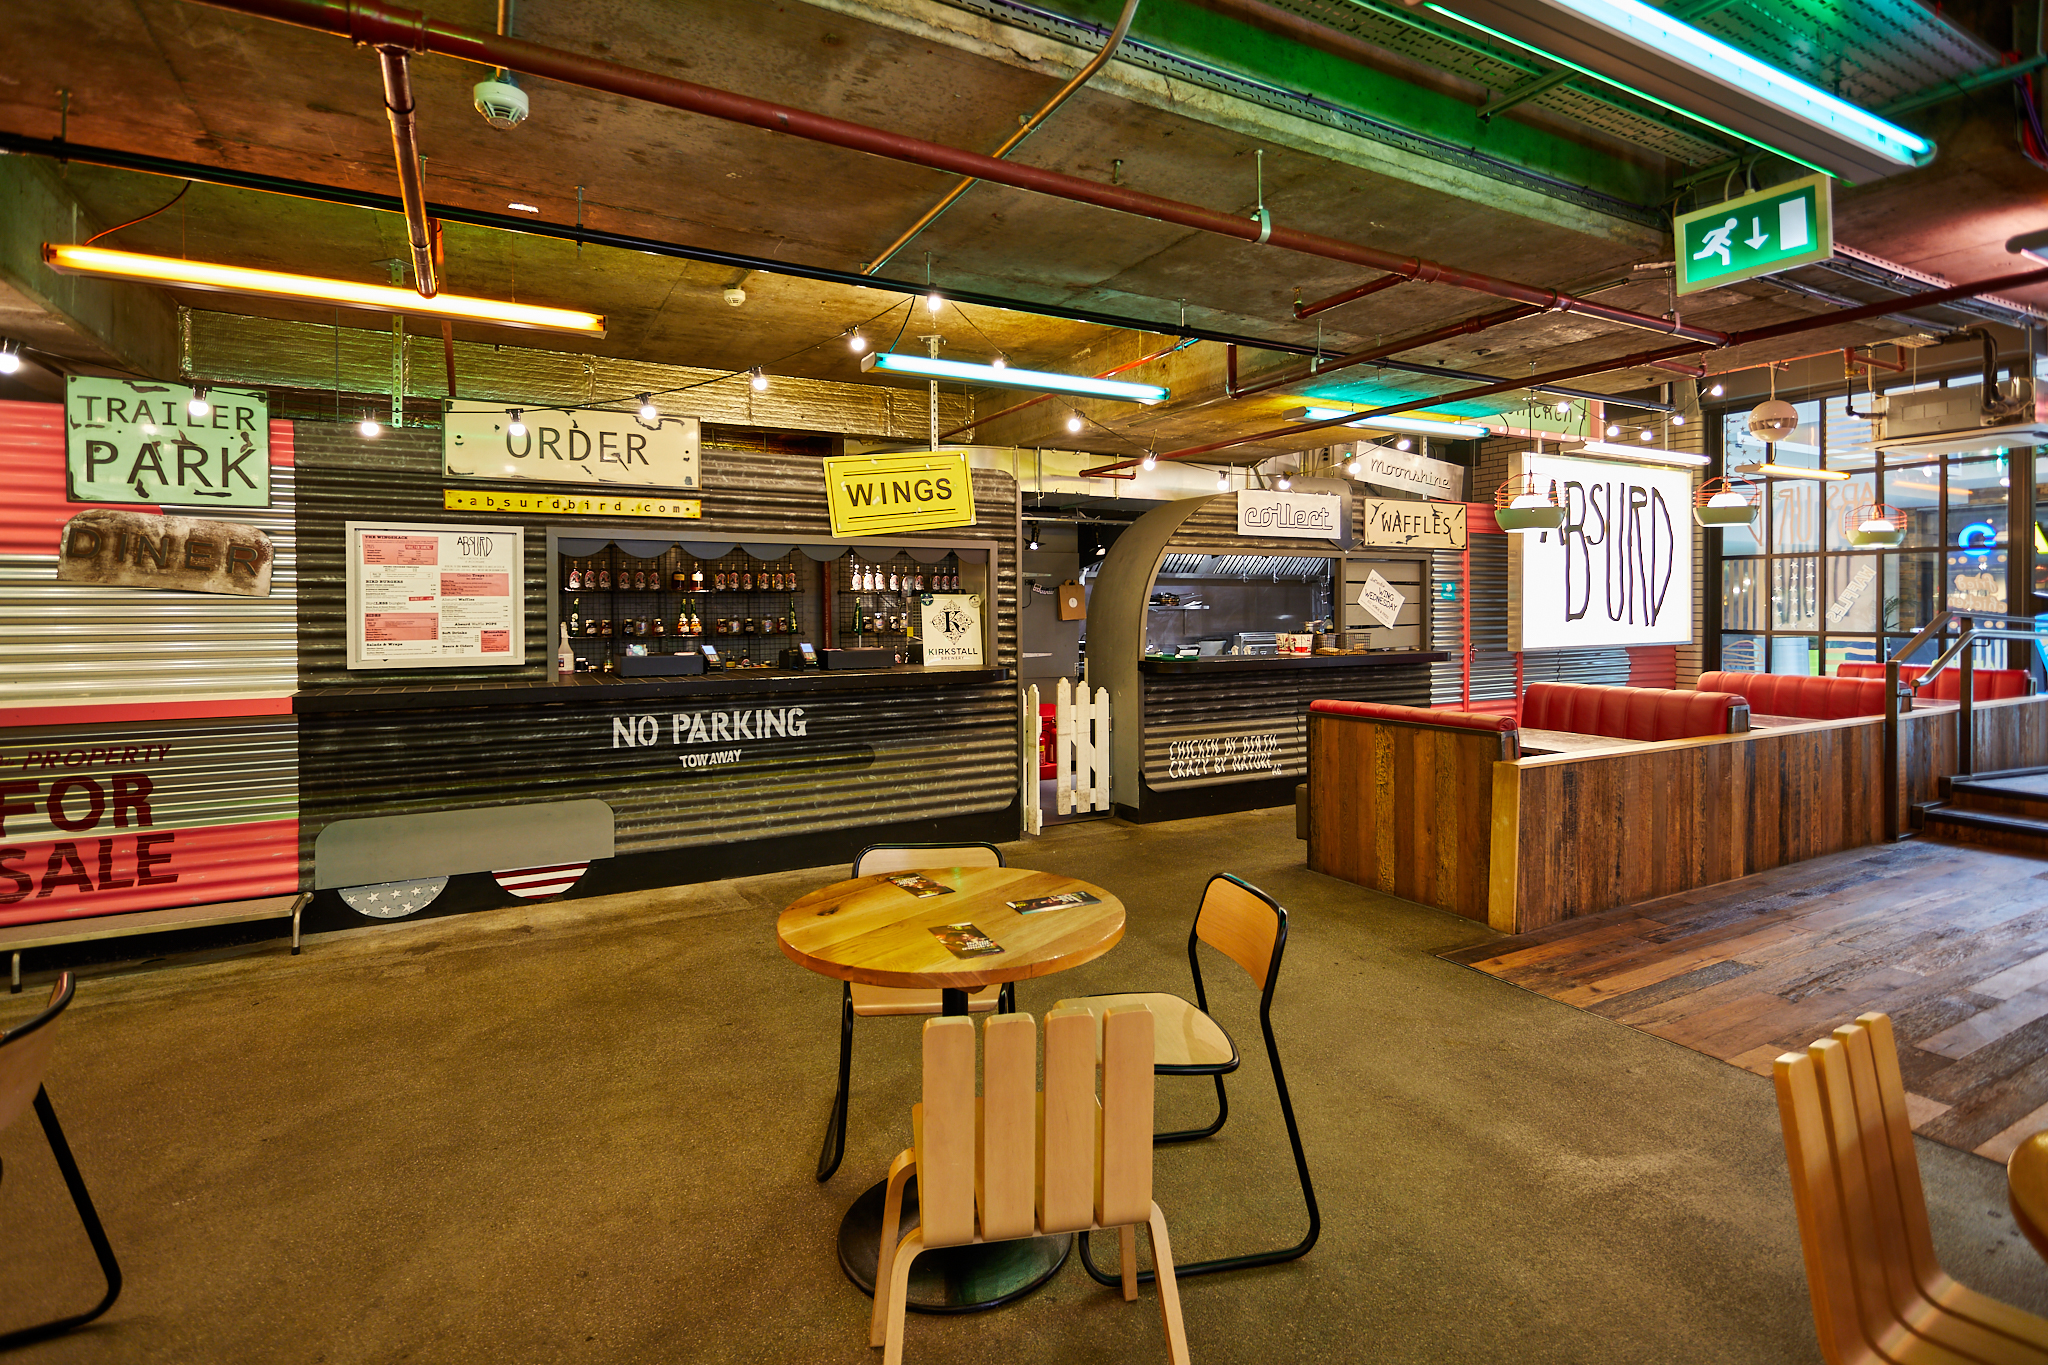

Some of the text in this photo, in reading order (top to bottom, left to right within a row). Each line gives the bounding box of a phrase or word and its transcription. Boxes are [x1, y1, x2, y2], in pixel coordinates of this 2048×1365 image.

[77, 395, 256, 431] TRAILER
[506, 426, 649, 466] ORDER
[86, 439, 258, 489] PARK
[470, 496, 681, 514] absurdbird.com
[845, 477, 952, 507] WINGS
[1243, 502, 1333, 530] collect
[1381, 510, 1451, 535] WAFFLES
[66, 527, 261, 576] DINER
[457, 536, 493, 557] ABSURD
[942, 610, 966, 633] K
[928, 647, 978, 656] KIRKSTALL
[612, 707, 807, 748] NO PARKING
[22, 743, 172, 770] PROPERTY
[1168, 738, 1220, 761] CHICKEN
[1224, 736, 1239, 757] BY
[1168, 758, 1210, 779] CRAZY
[1213, 756, 1228, 774] BY
[0, 773, 154, 838] FOR
[0, 832, 179, 905] SALE
